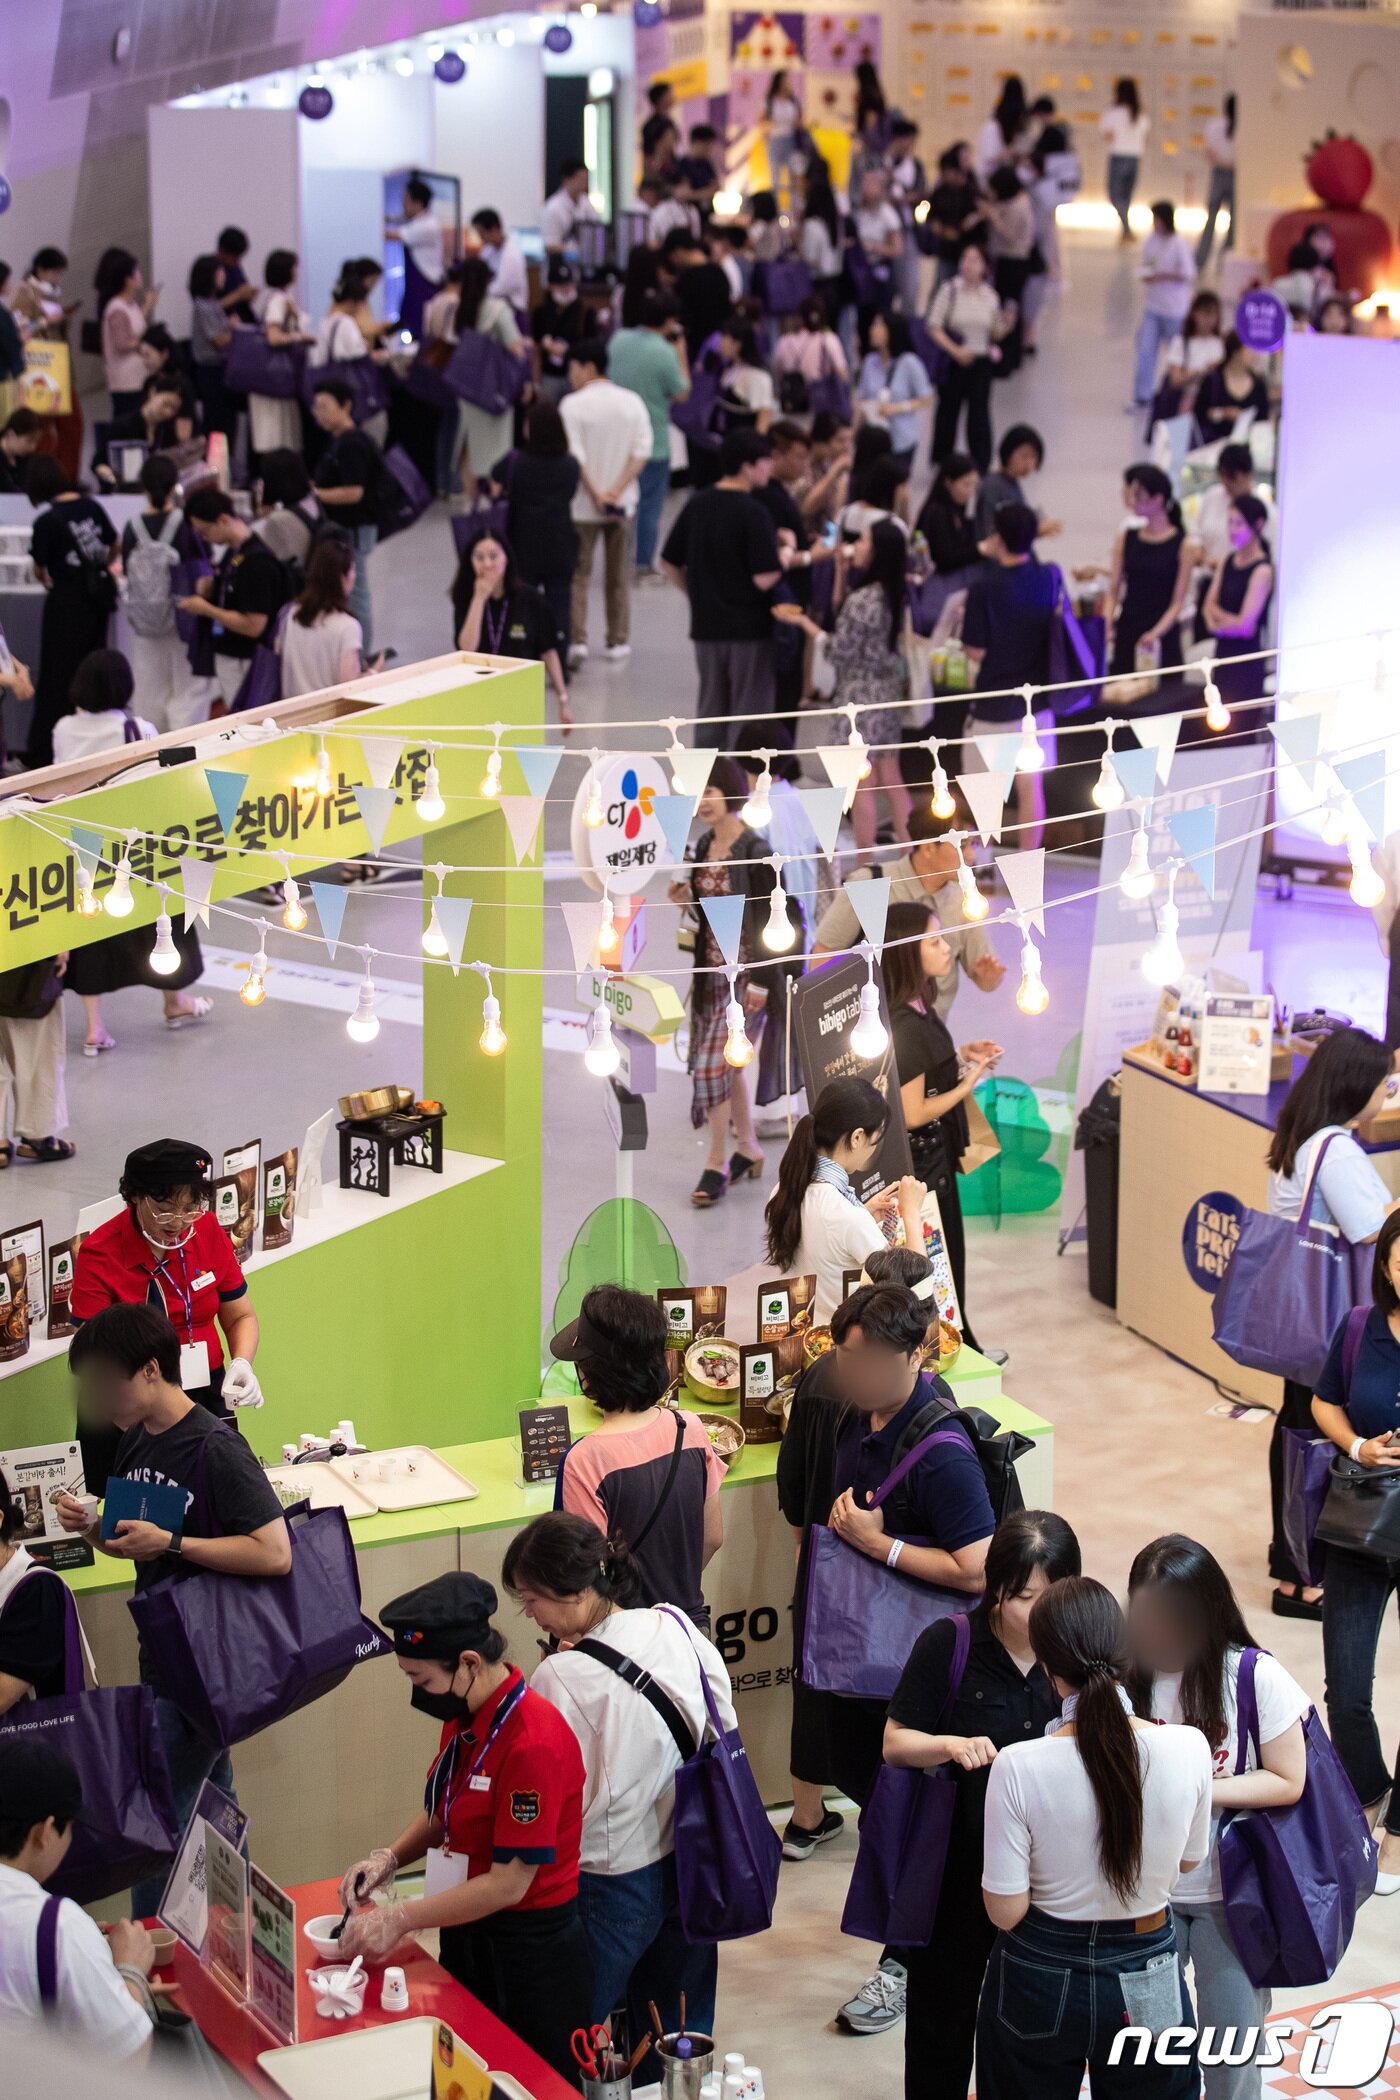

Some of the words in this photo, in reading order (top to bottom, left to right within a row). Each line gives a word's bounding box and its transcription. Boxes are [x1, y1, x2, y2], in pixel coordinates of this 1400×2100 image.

[606, 800, 627, 828] CJ
[0, 855, 75, 931] 신의
[235, 772, 363, 858] 찾아가는
[592, 976, 633, 1016] bbigo
[818, 1009, 848, 1036] bibigo
[1196, 1246, 1229, 1278] Tei
[16, 1469, 45, 1483] 본갈비탕
[47, 1466, 66, 1478] 출시!
[354, 1634, 381, 1658] Kurly
[17, 1721, 39, 1732] FOOD
[40, 1718, 59, 1728] LOVE
[59, 1714, 76, 1724] LIFE
